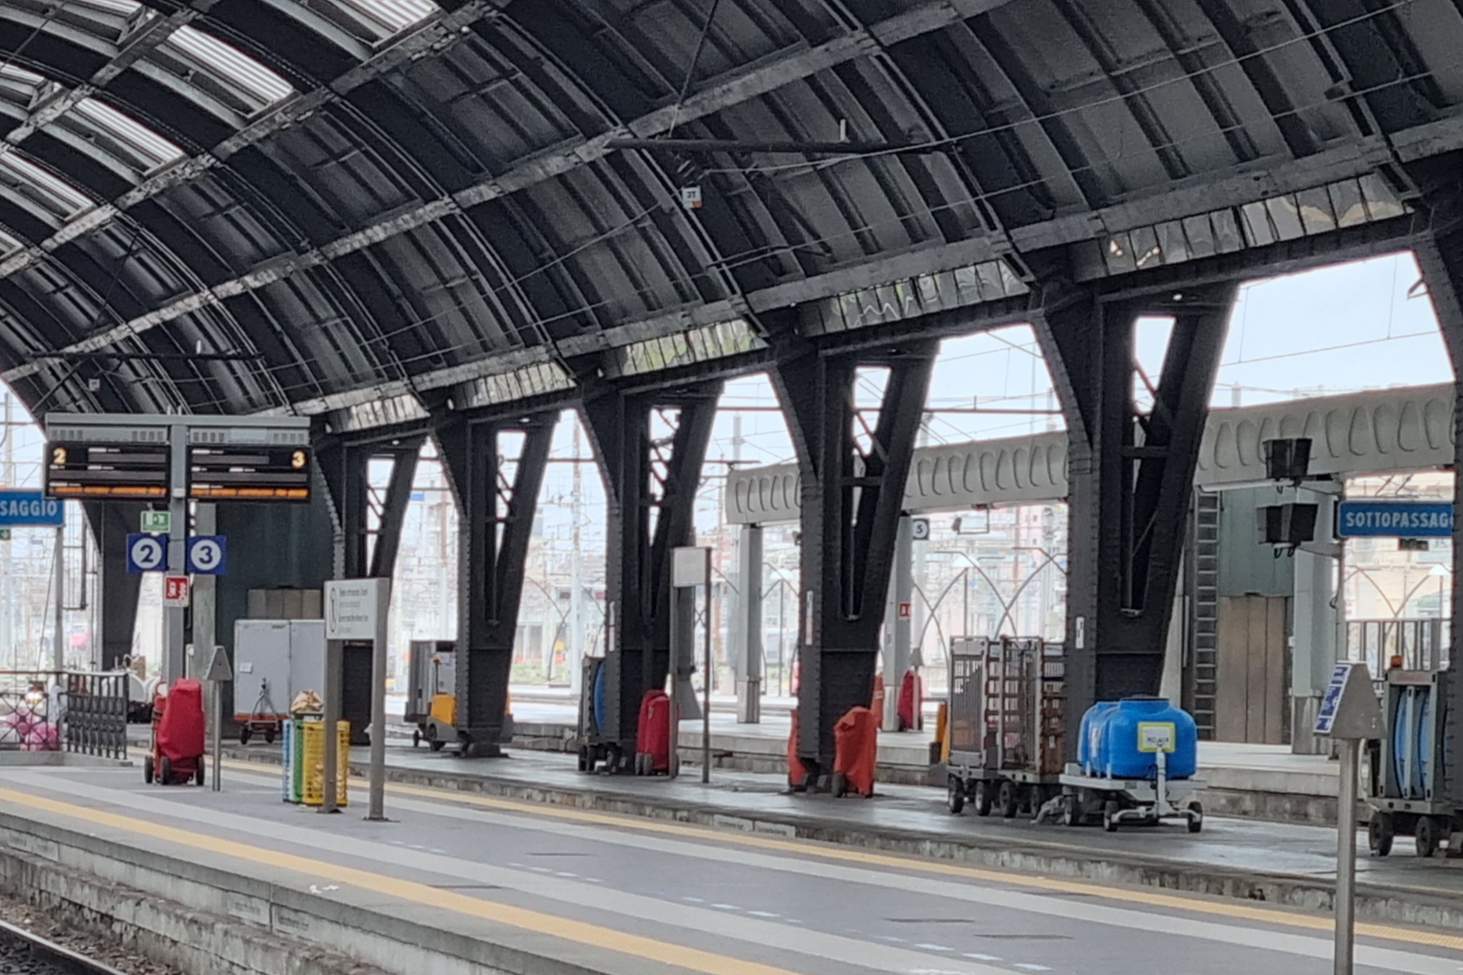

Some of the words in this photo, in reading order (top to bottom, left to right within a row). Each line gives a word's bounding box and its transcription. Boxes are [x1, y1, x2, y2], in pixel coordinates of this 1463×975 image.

[53, 448, 66, 465] 2
[292, 451, 305, 468] 3
[140, 544, 154, 563] 2
[198, 545, 213, 564] 3
